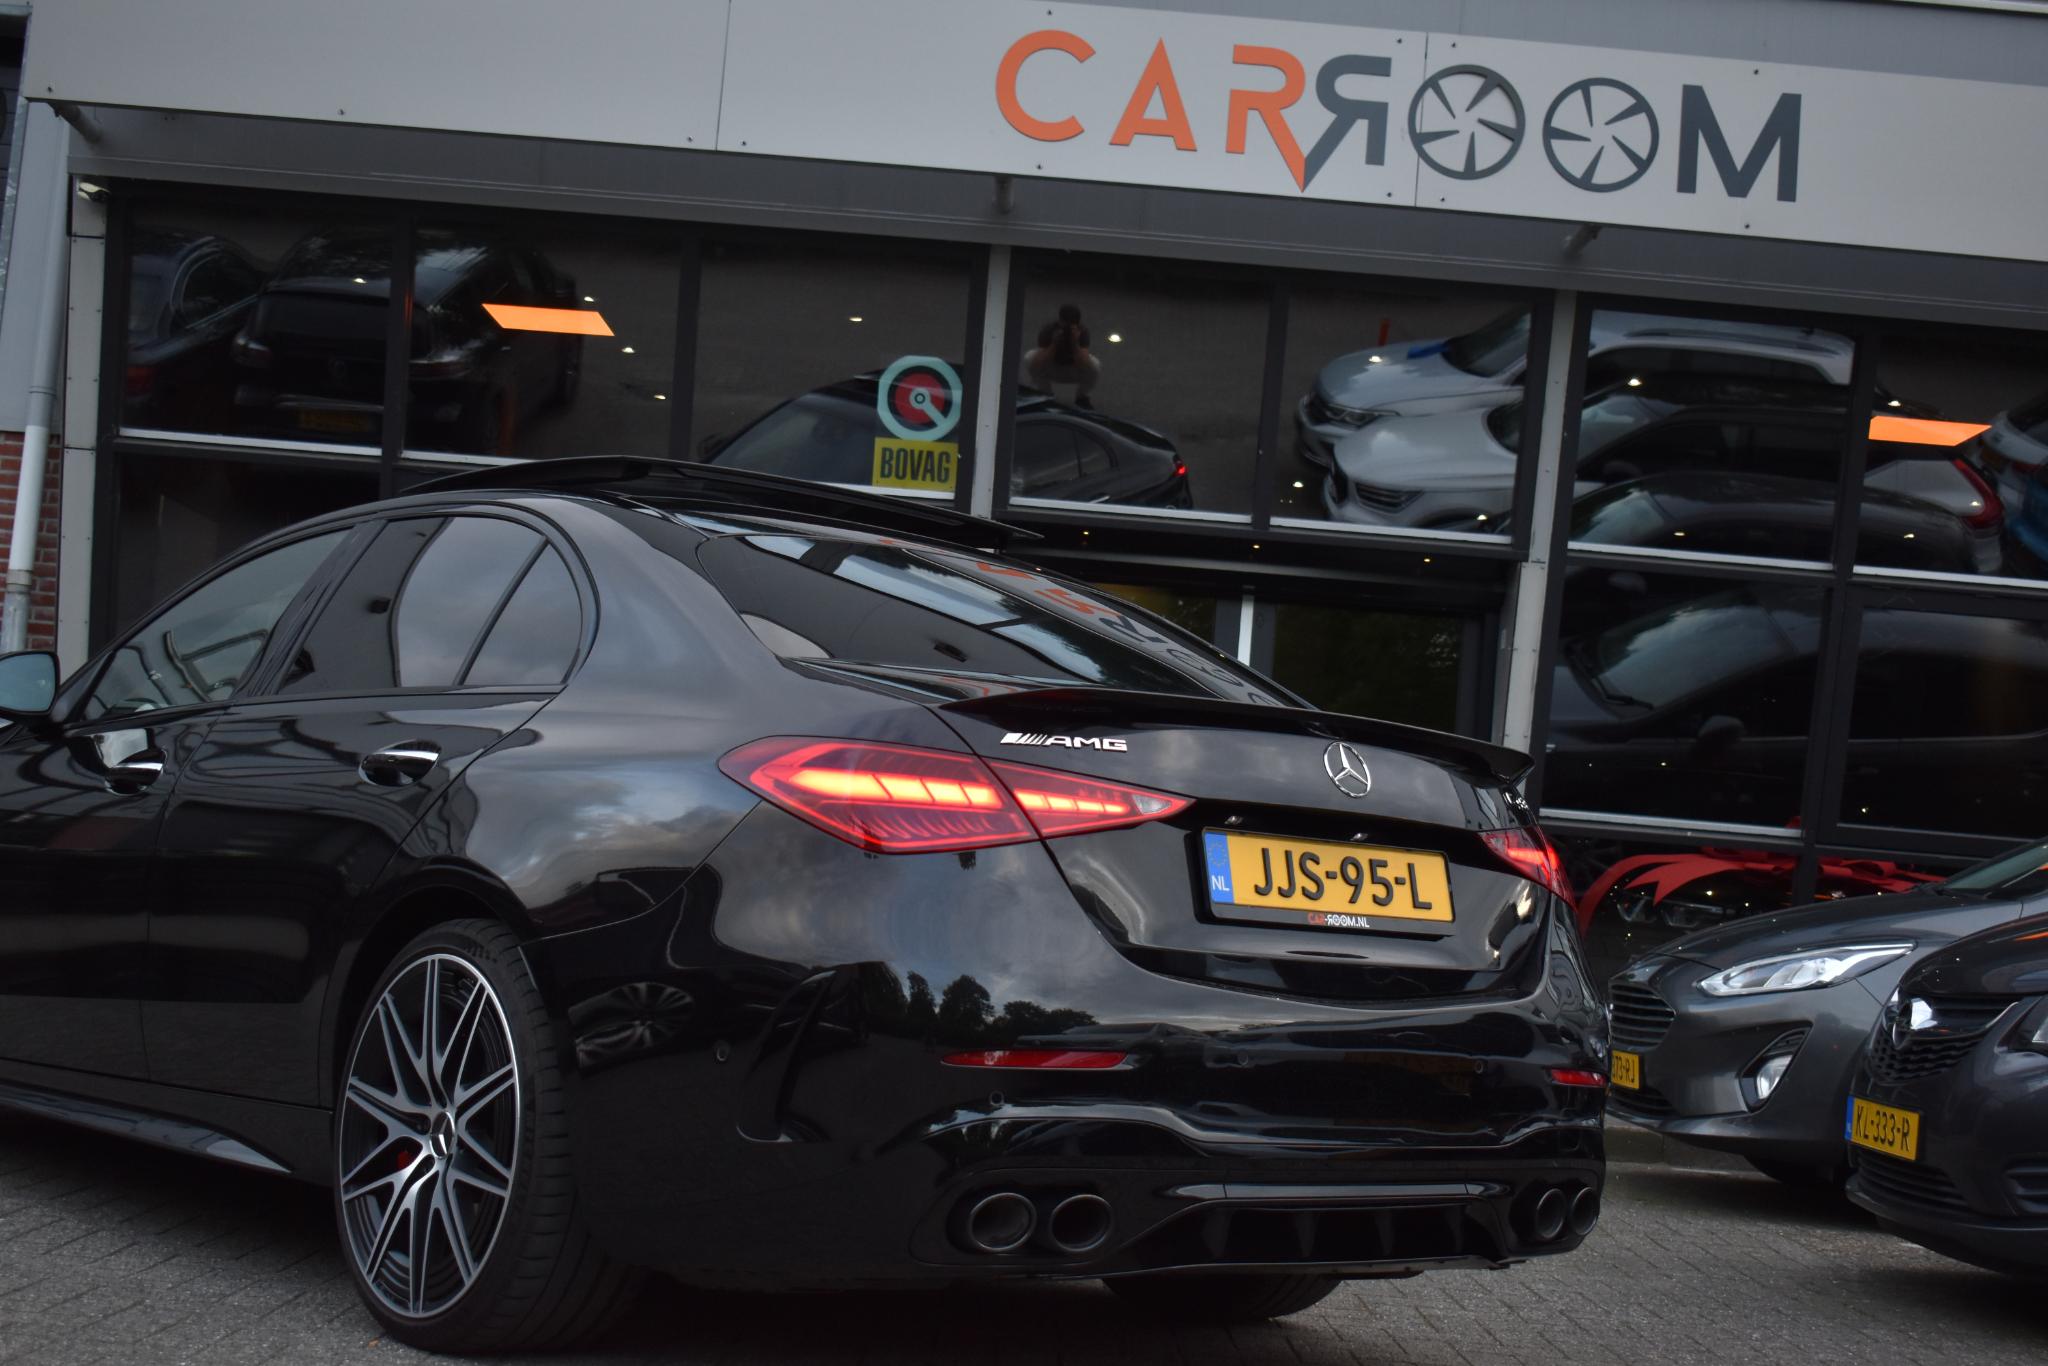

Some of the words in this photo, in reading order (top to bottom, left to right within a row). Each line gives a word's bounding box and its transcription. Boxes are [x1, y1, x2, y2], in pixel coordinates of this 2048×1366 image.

[880, 447, 951, 483] BOVAG
[1044, 735, 1128, 752] AMG
[1211, 875, 1230, 892] NL
[1254, 847, 1433, 910] JJS-95-L
[1855, 1104, 1911, 1152] KL-333-R
